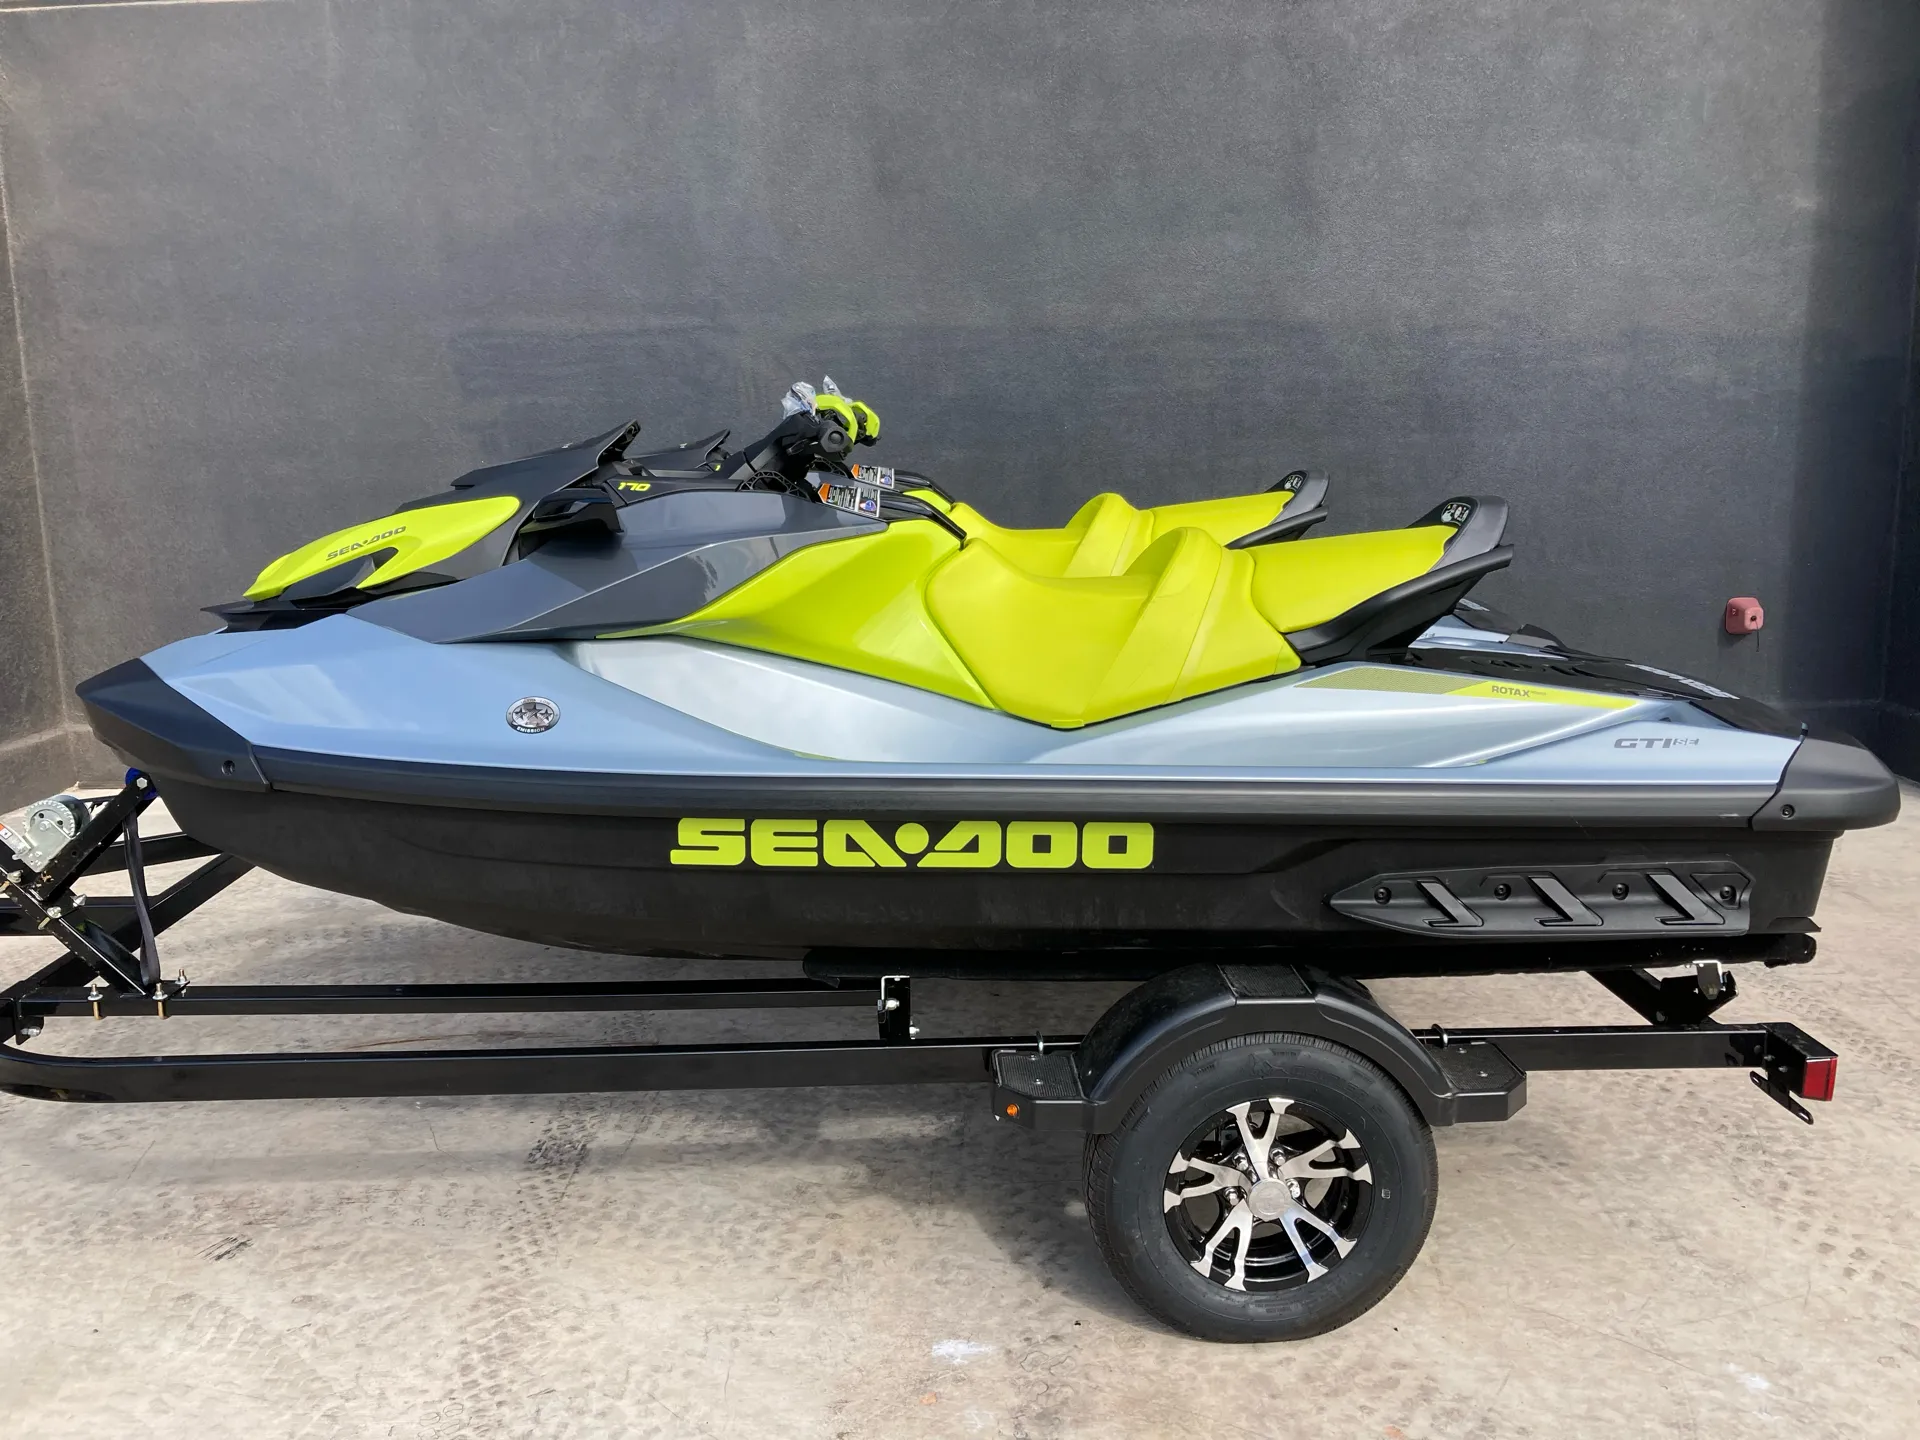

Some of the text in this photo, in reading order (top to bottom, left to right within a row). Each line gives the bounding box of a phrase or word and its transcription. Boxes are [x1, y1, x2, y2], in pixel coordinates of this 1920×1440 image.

[617, 482, 651, 492] 170
[1491, 685, 1530, 697] ROTAX
[1614, 738, 1673, 749] GTI
